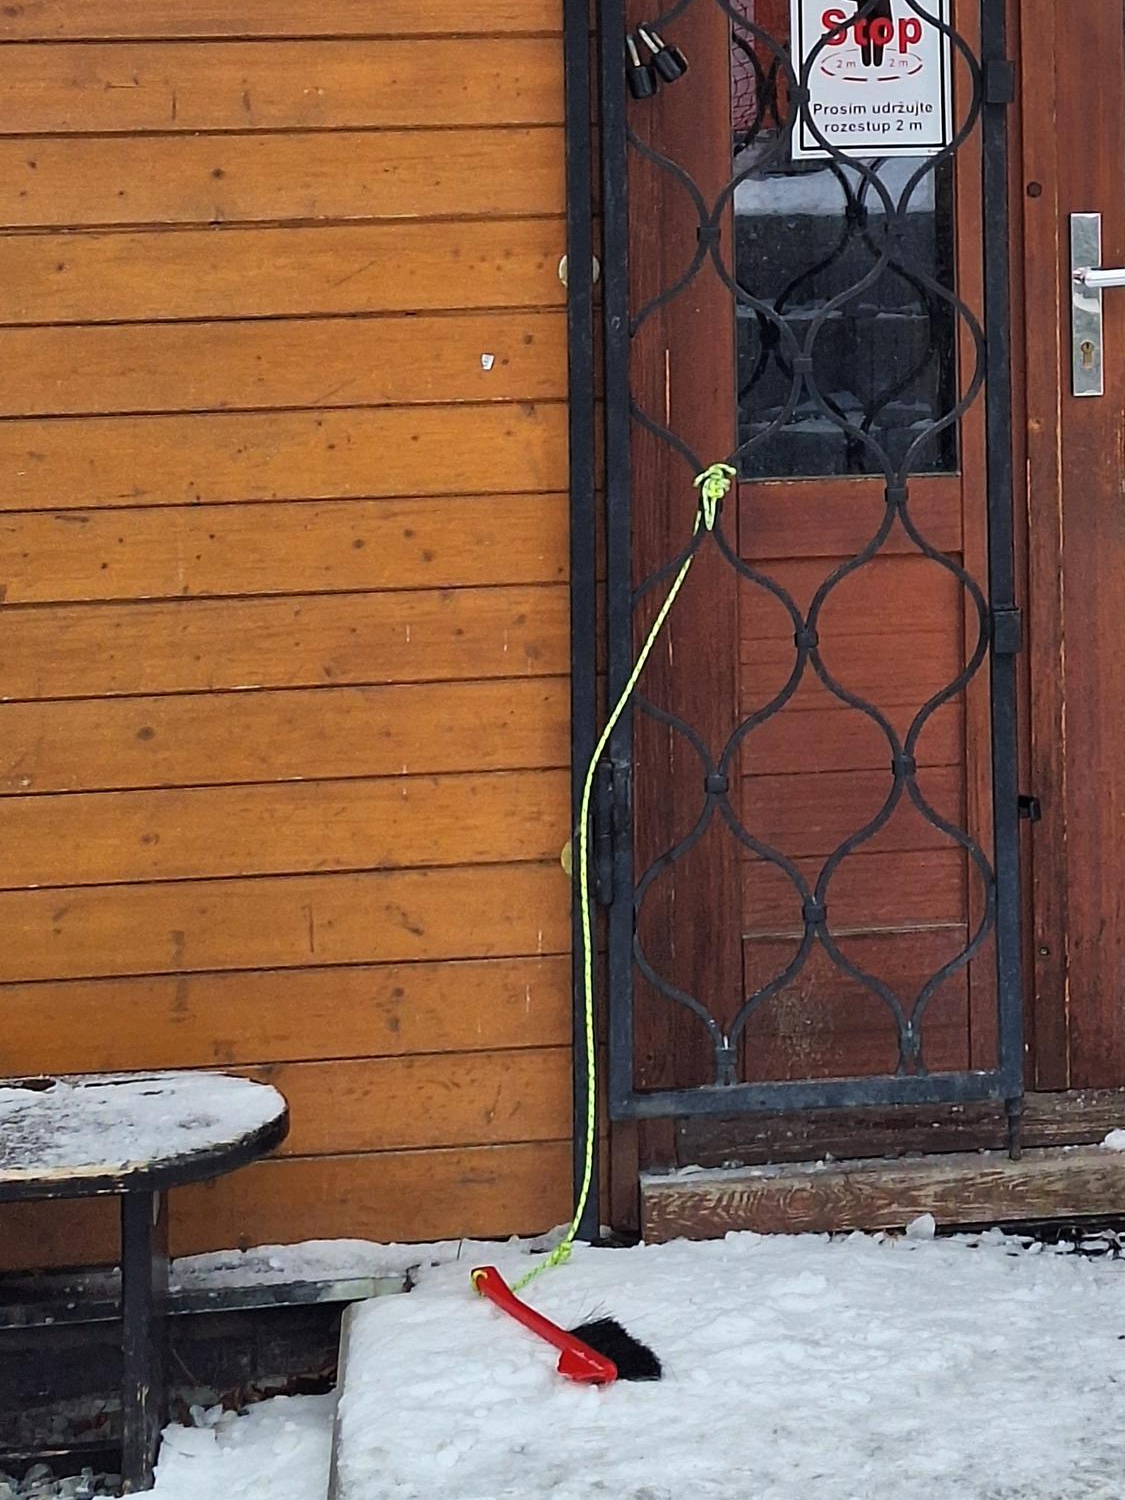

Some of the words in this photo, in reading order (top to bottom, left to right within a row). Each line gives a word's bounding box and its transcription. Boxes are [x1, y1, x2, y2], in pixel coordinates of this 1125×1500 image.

[822, 8, 922, 54] Stop
[836, 59, 845, 68] 2
[846, 60, 857, 68] m
[889, 58, 897, 68] 2
[898, 59, 909, 68] m
[813, 102, 867, 115] Prosím
[872, 101, 933, 116] udržujte
[824, 121, 891, 134] rozestup
[896, 119, 904, 131] 2
[909, 121, 923, 131] m
